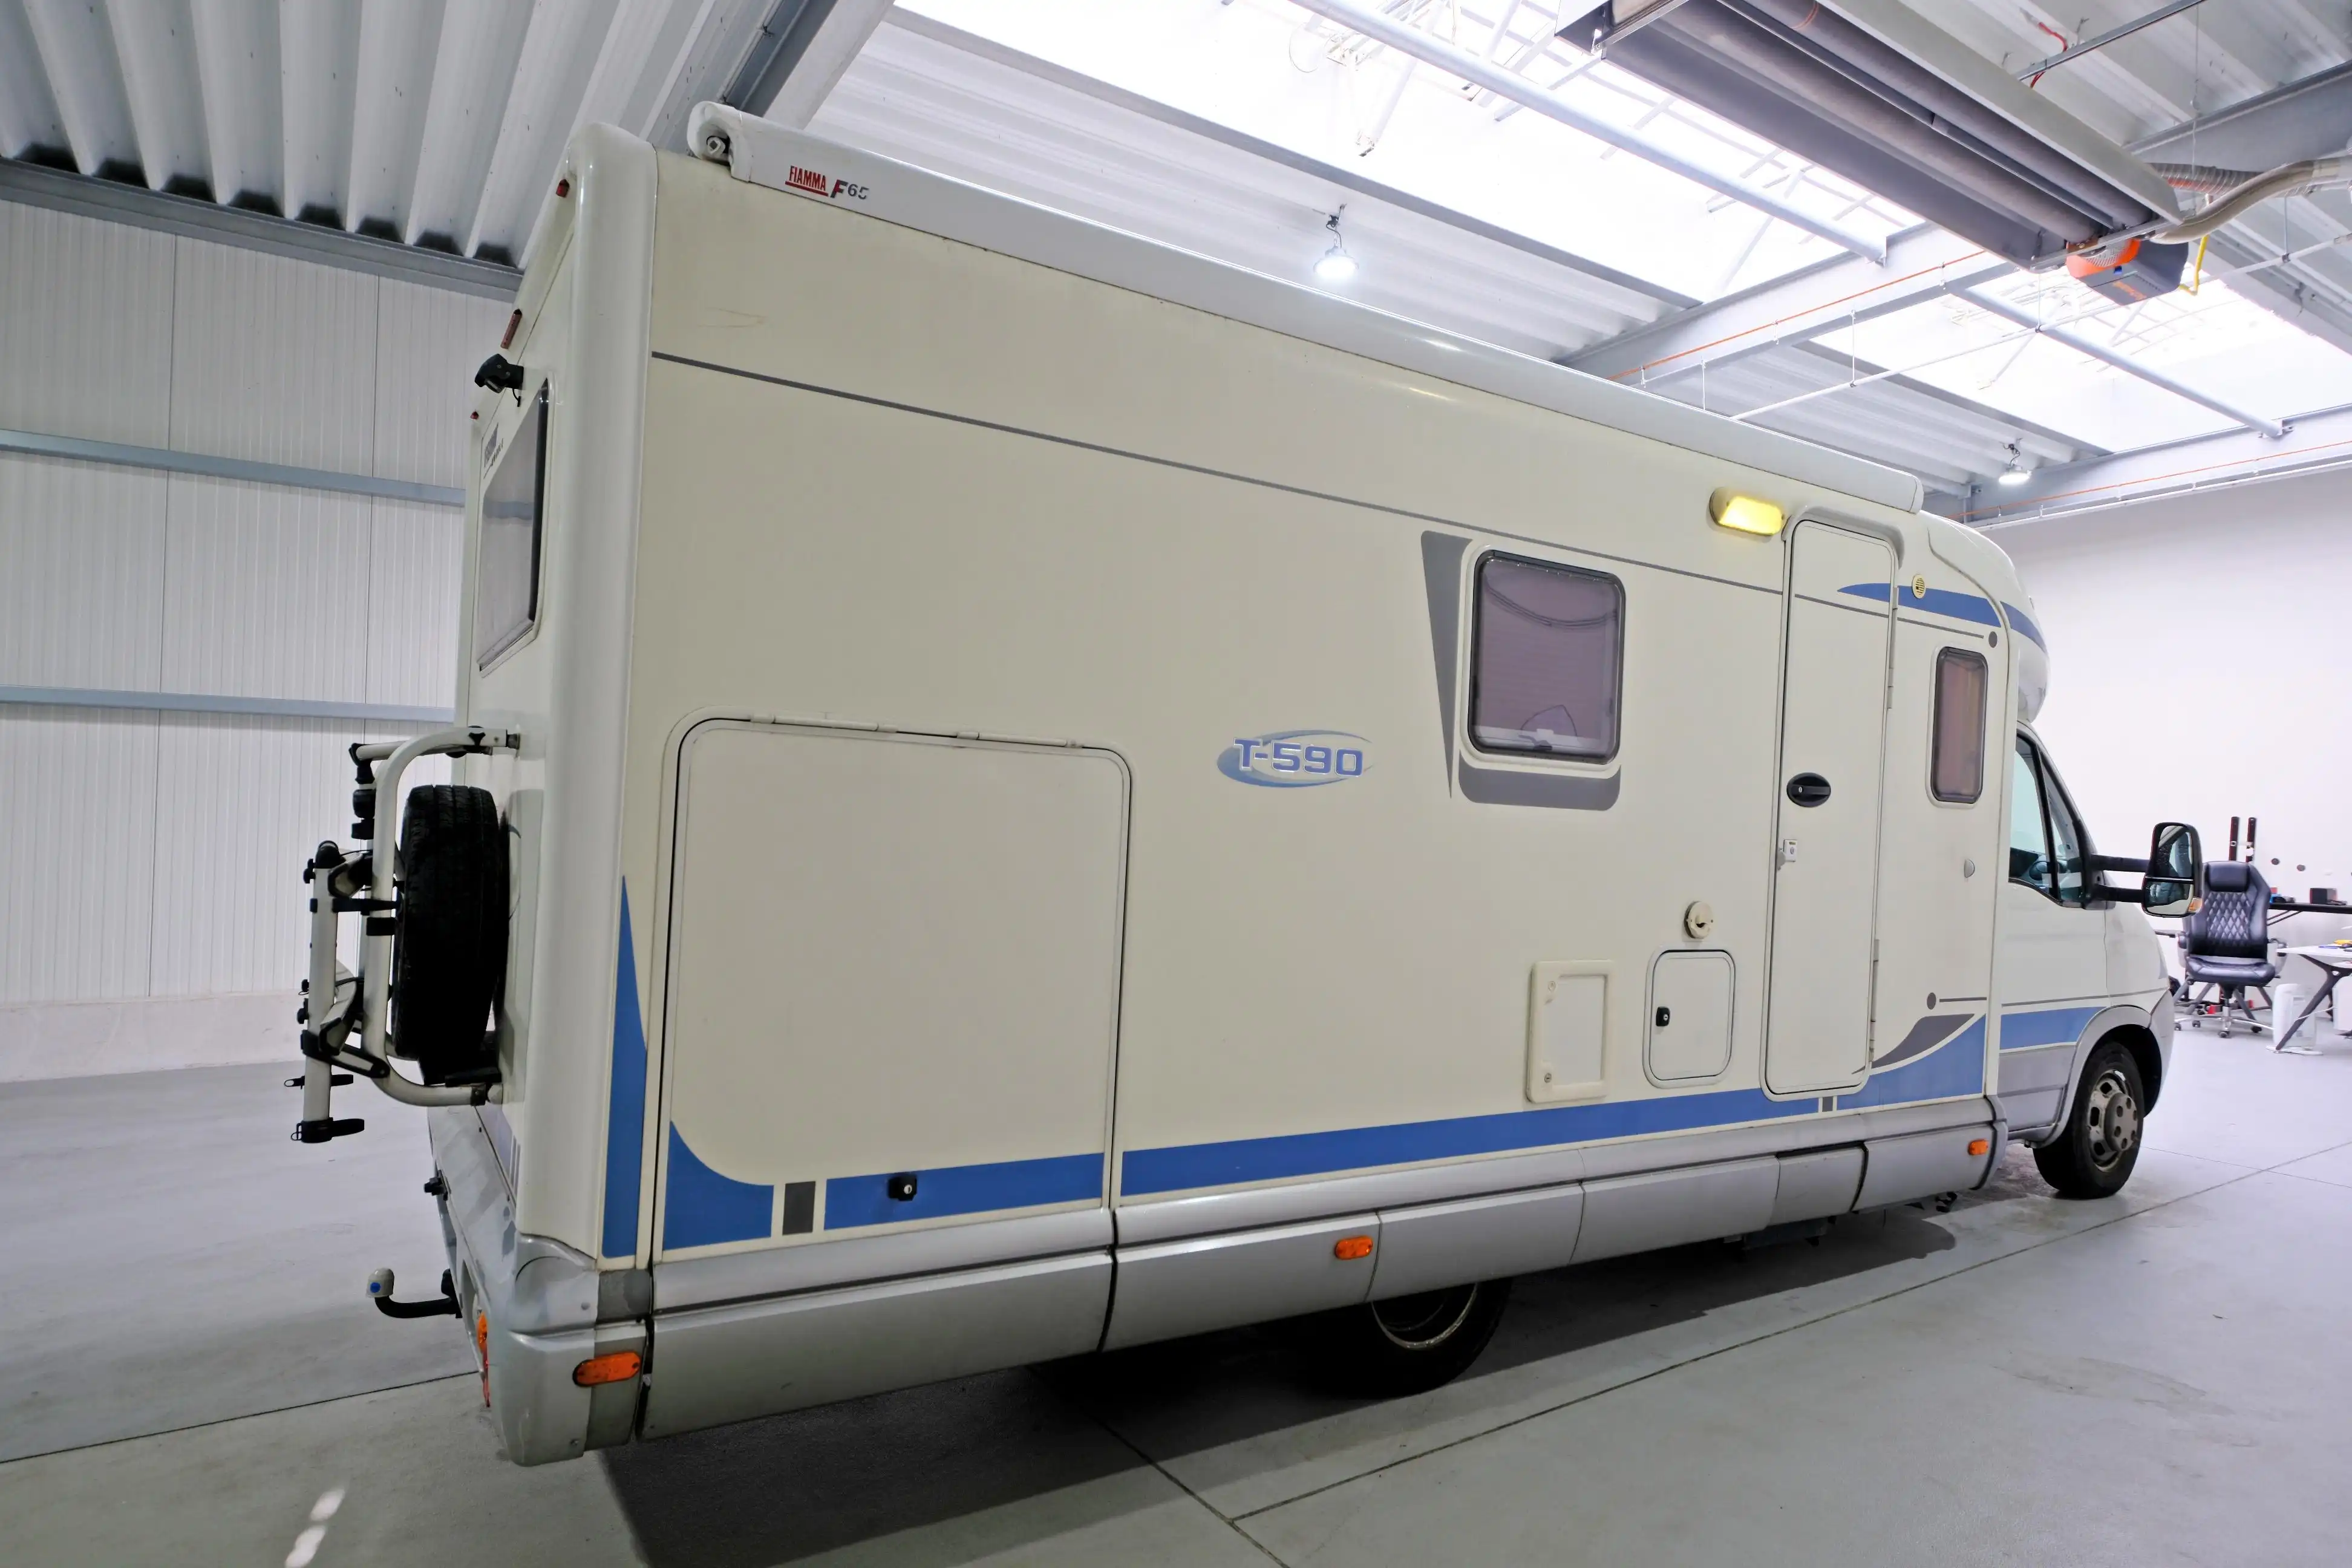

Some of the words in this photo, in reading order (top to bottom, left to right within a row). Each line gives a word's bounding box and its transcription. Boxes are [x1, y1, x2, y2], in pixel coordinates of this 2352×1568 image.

[789, 165, 826, 191] FIAMMA
[830, 179, 869, 200] F65
[1233, 737, 1364, 777] T-590
